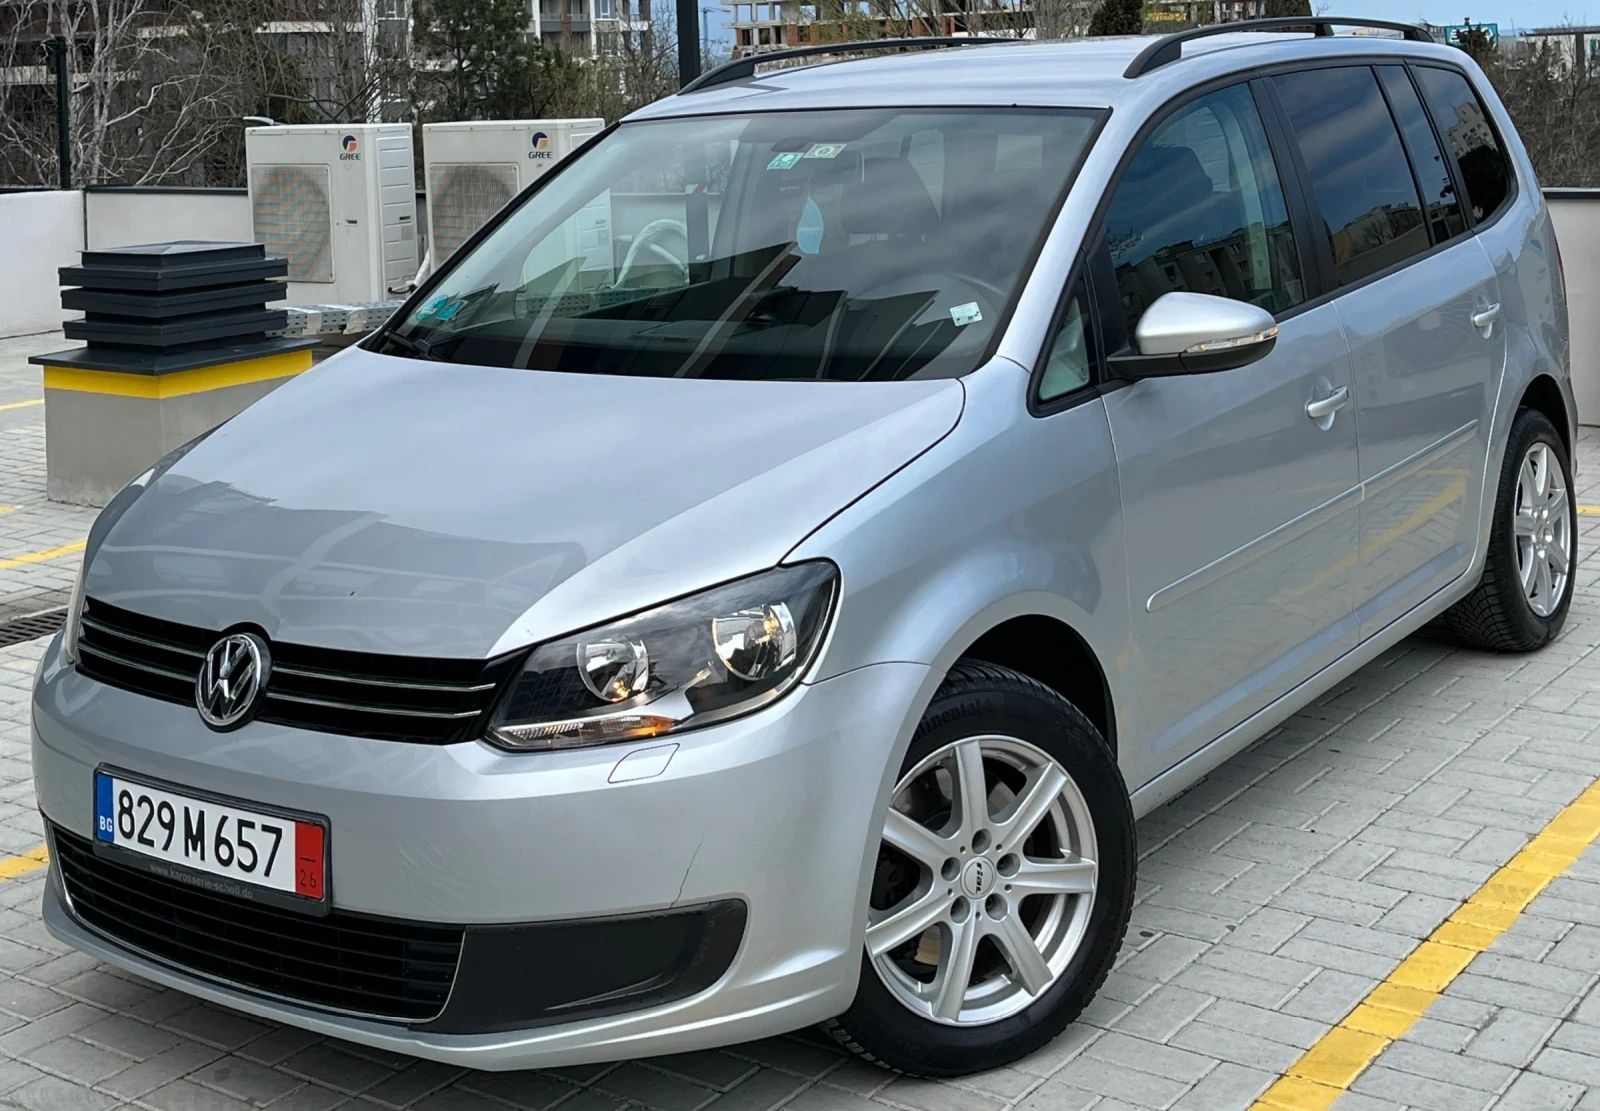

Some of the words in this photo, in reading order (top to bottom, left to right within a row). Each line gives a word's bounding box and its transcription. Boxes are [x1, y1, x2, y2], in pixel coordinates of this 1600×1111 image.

[339, 152, 361, 161] GREE
[528, 151, 553, 160] GREE
[99, 815, 113, 833] BG
[118, 789, 176, 852] 829
[184, 806, 206, 861] M
[214, 815, 283, 878] 657
[299, 869, 317, 889] 26
